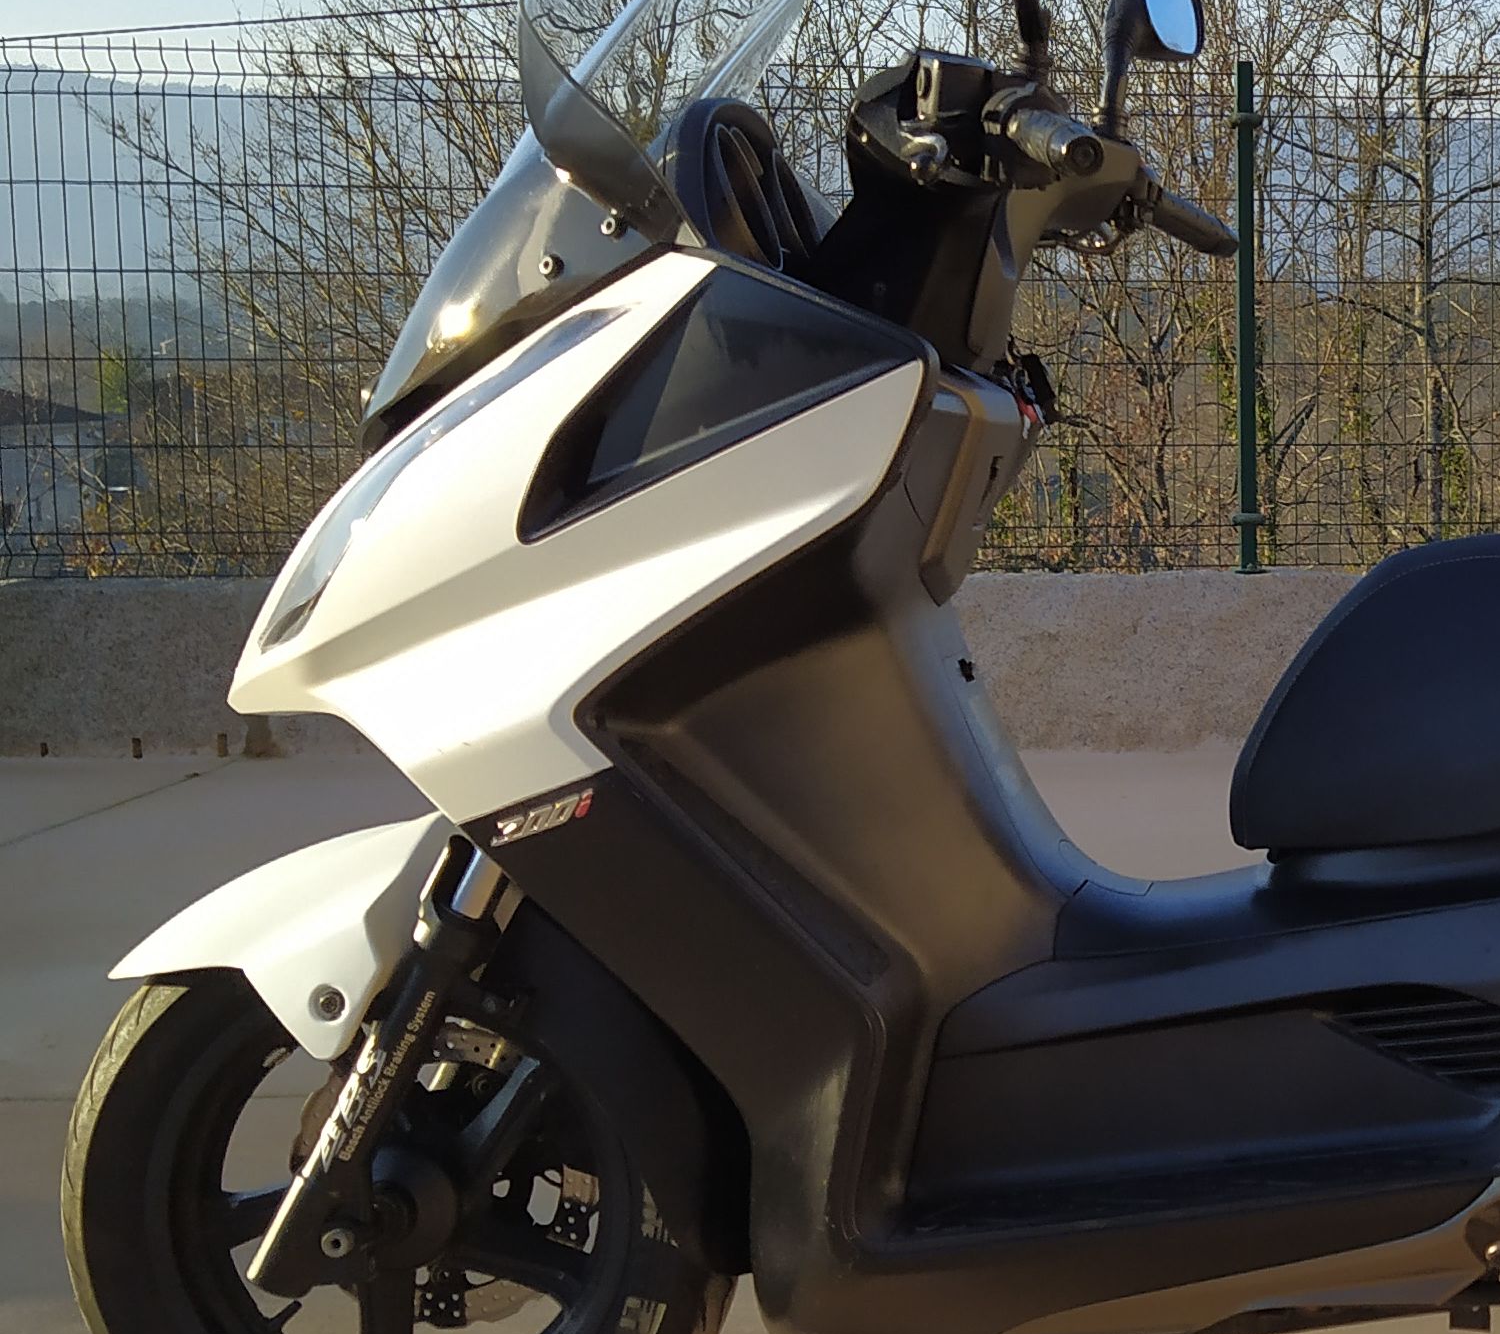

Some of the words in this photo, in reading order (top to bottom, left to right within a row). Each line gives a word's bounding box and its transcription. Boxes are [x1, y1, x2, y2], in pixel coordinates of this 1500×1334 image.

[339, 1124, 366, 1162] Bosch
[360, 1077, 391, 1124] Antilock
[383, 1033, 416, 1078] Braking
[406, 990, 436, 1032] System
